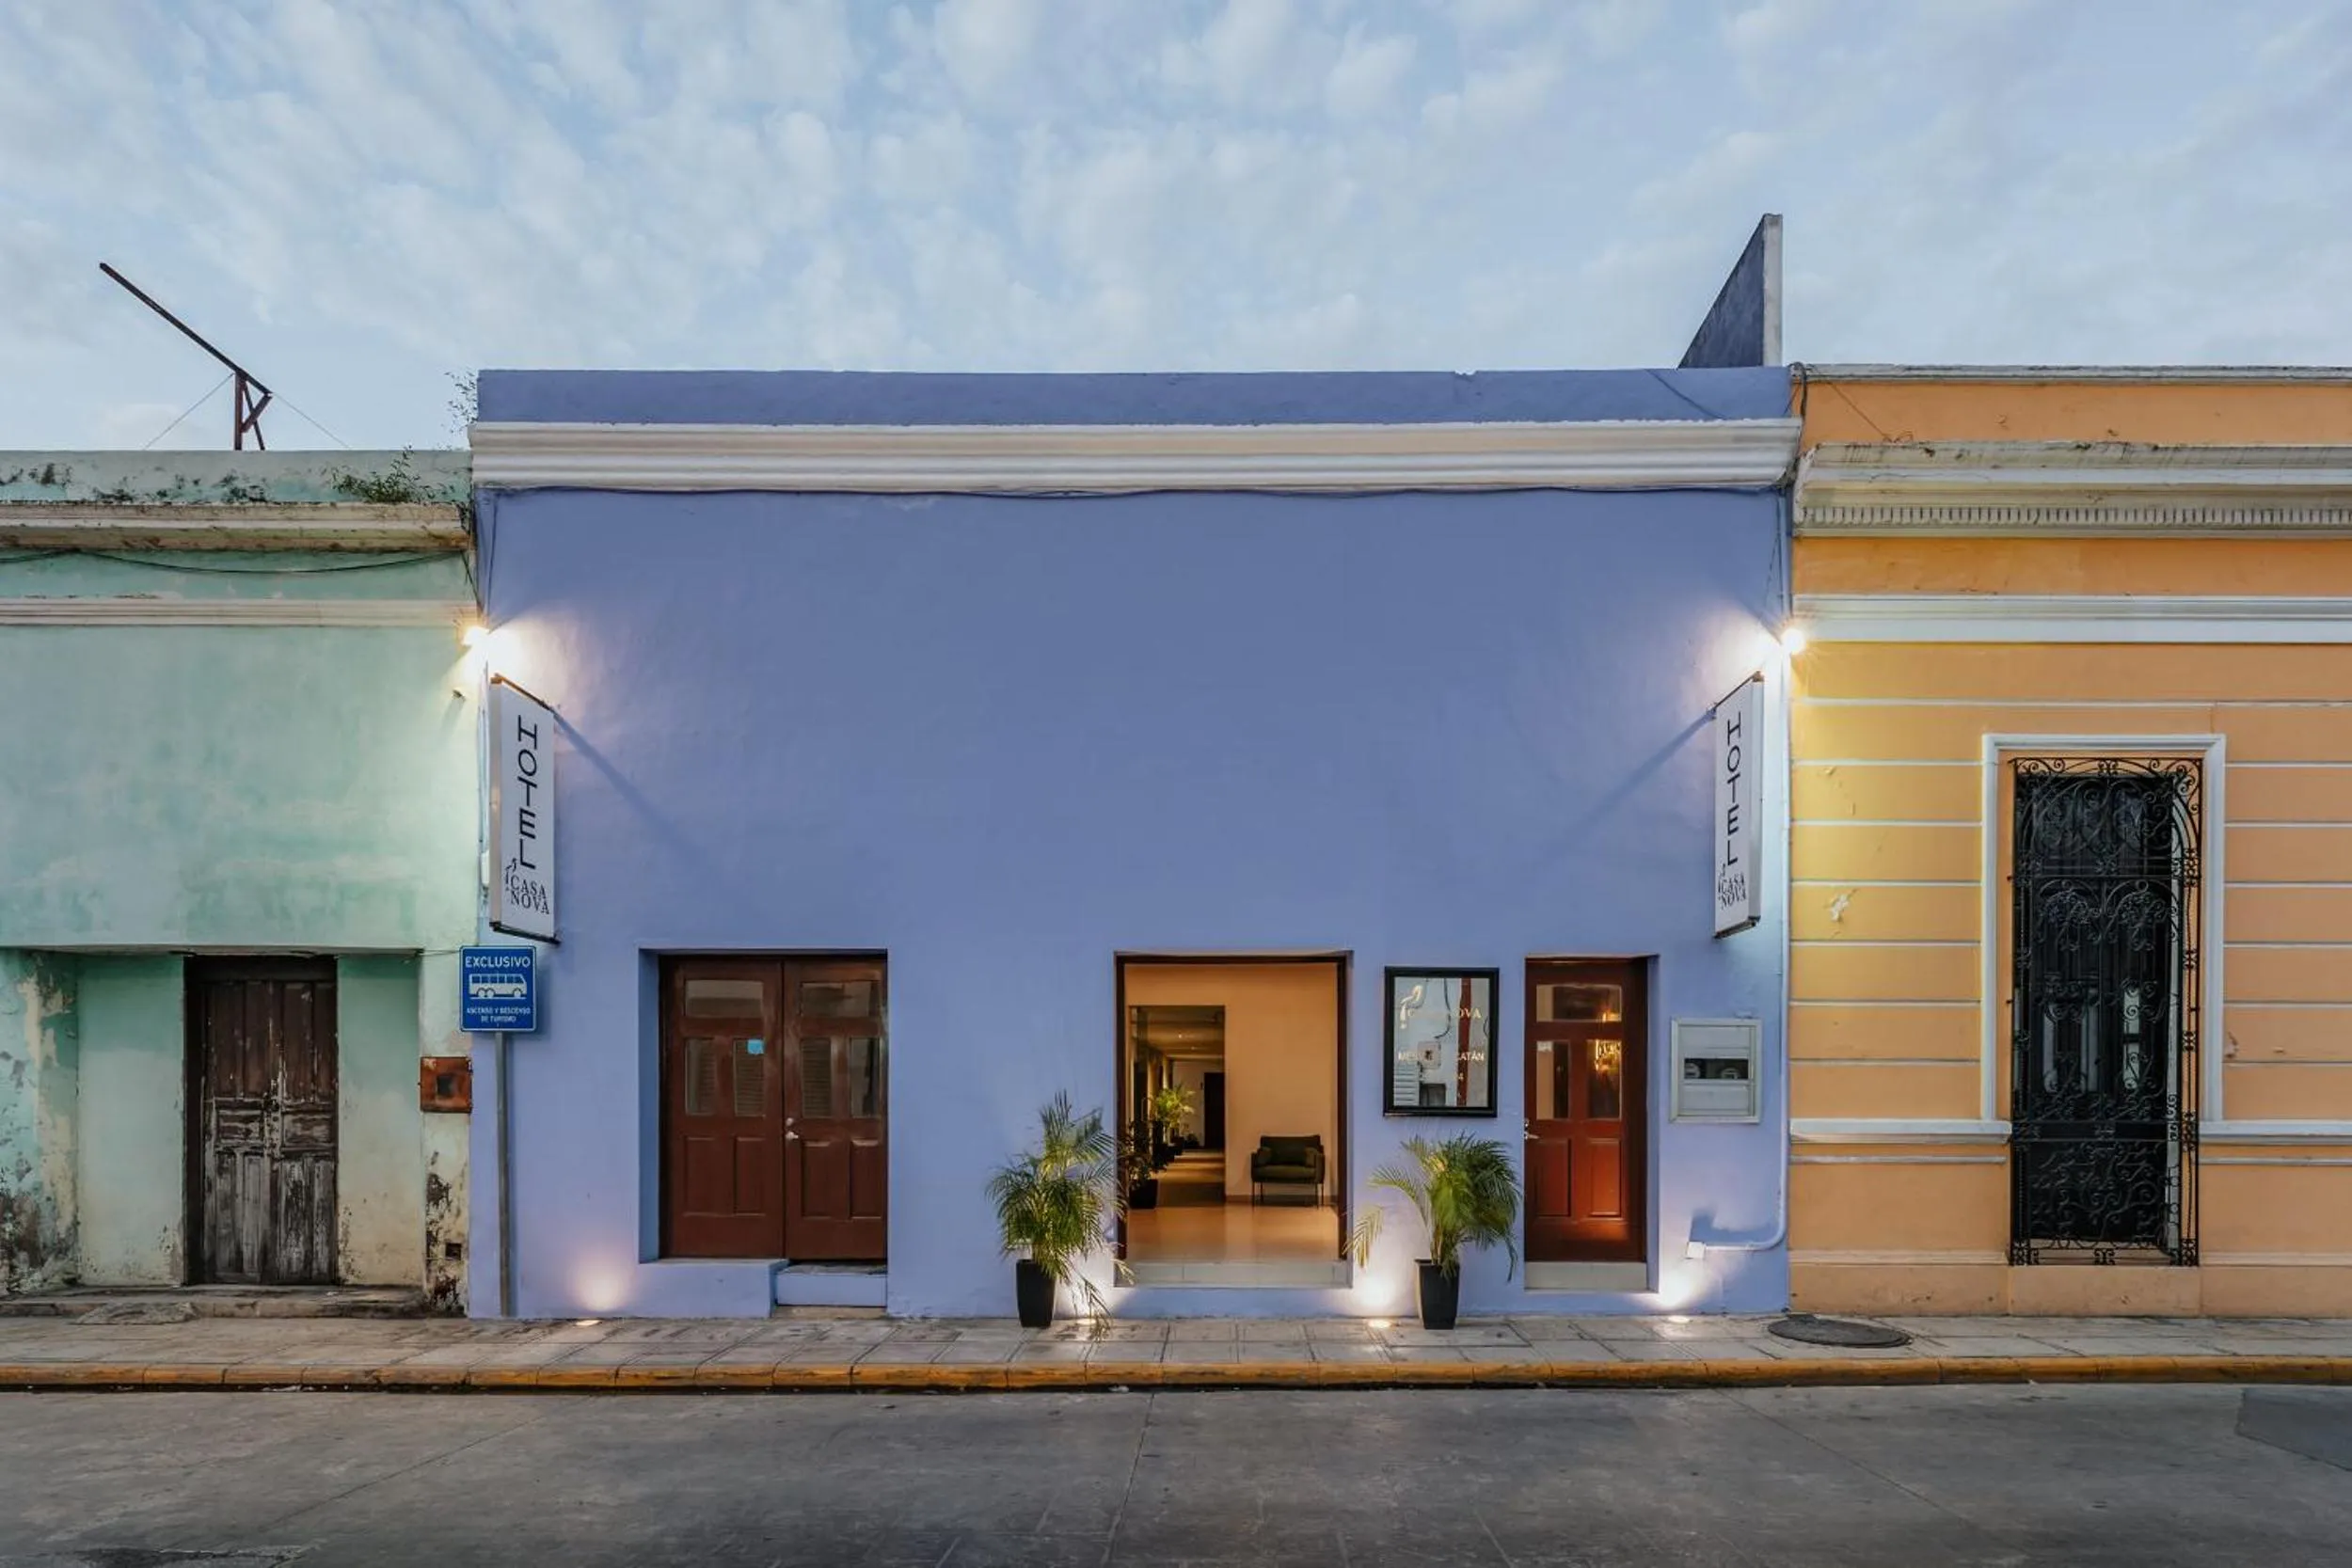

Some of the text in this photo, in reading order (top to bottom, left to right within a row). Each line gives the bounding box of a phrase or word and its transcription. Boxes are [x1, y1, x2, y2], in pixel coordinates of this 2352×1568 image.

[517, 714, 538, 870] HOTEL
[1726, 711, 1741, 865] HOTEL
[511, 875, 547, 899] CASA
[511, 890, 549, 915] NOVA
[465, 956, 531, 968] EXCLUSIVO
